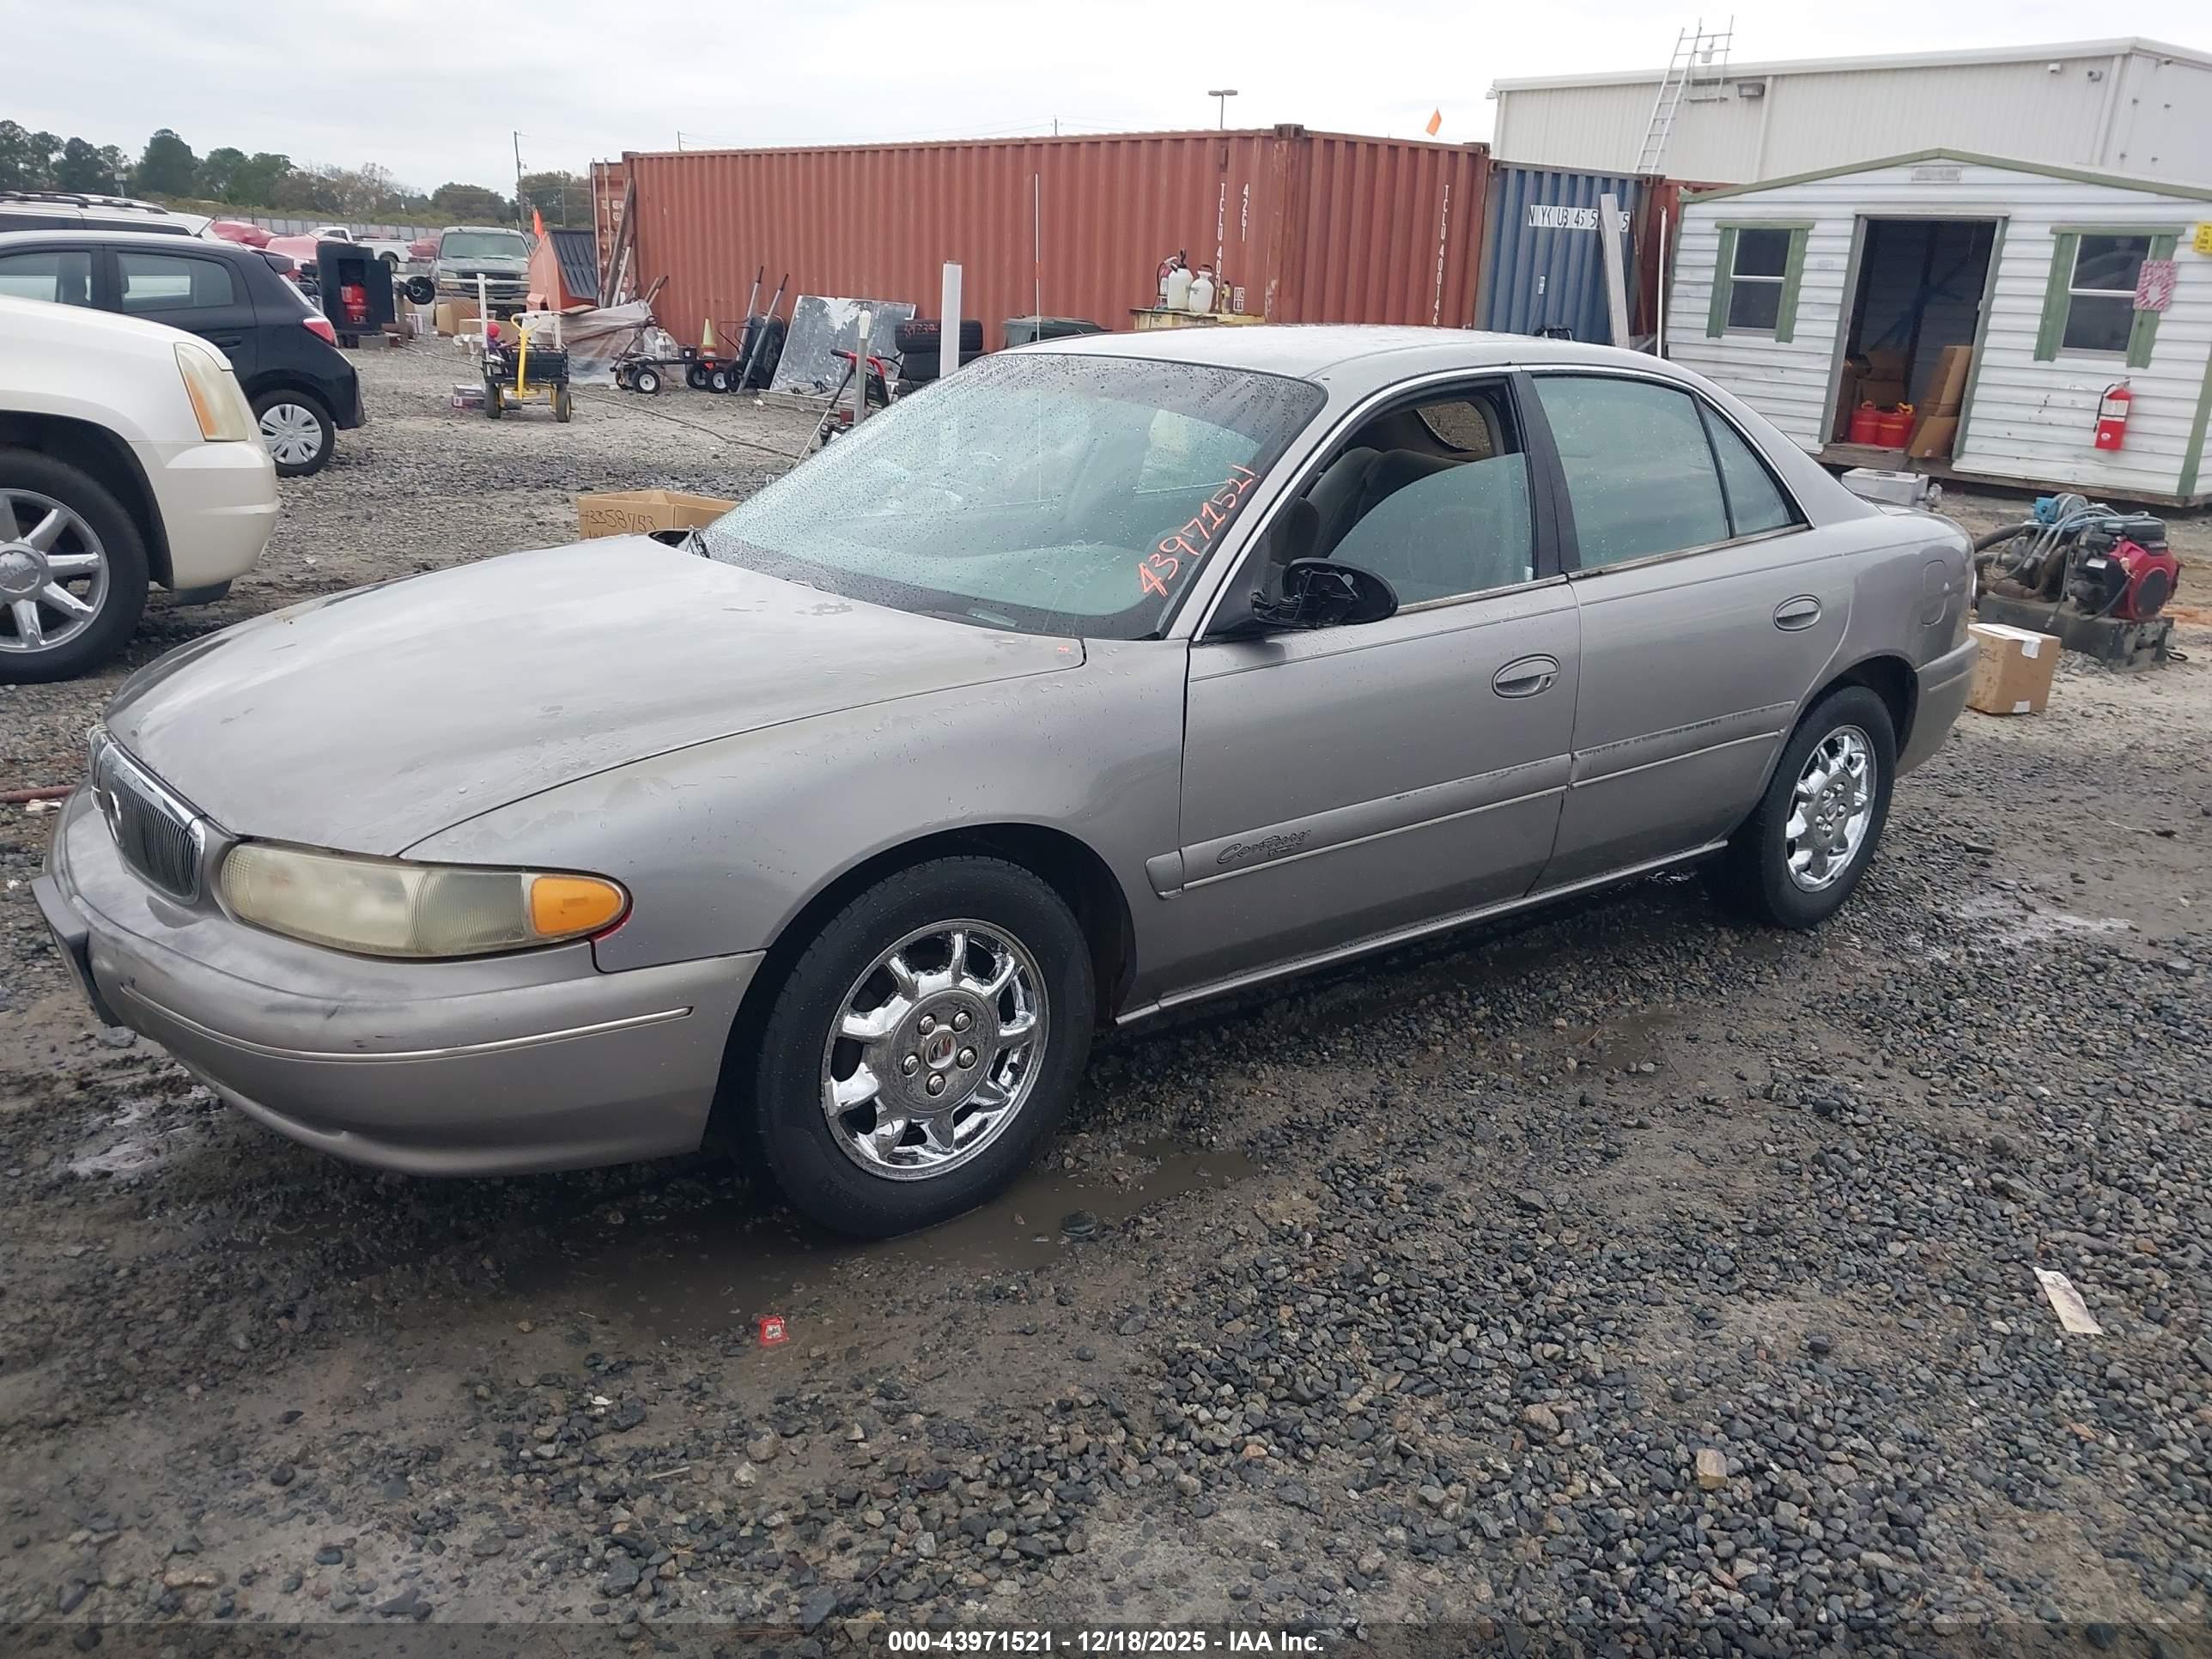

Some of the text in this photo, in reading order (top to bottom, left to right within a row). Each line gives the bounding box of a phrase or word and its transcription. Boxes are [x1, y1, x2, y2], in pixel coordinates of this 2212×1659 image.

[1217, 182, 1226, 241] TCLU
[1241, 182, 1250, 243] 42G1
[1440, 184, 1450, 240] TCLU
[1138, 465, 1258, 599] 43971521
